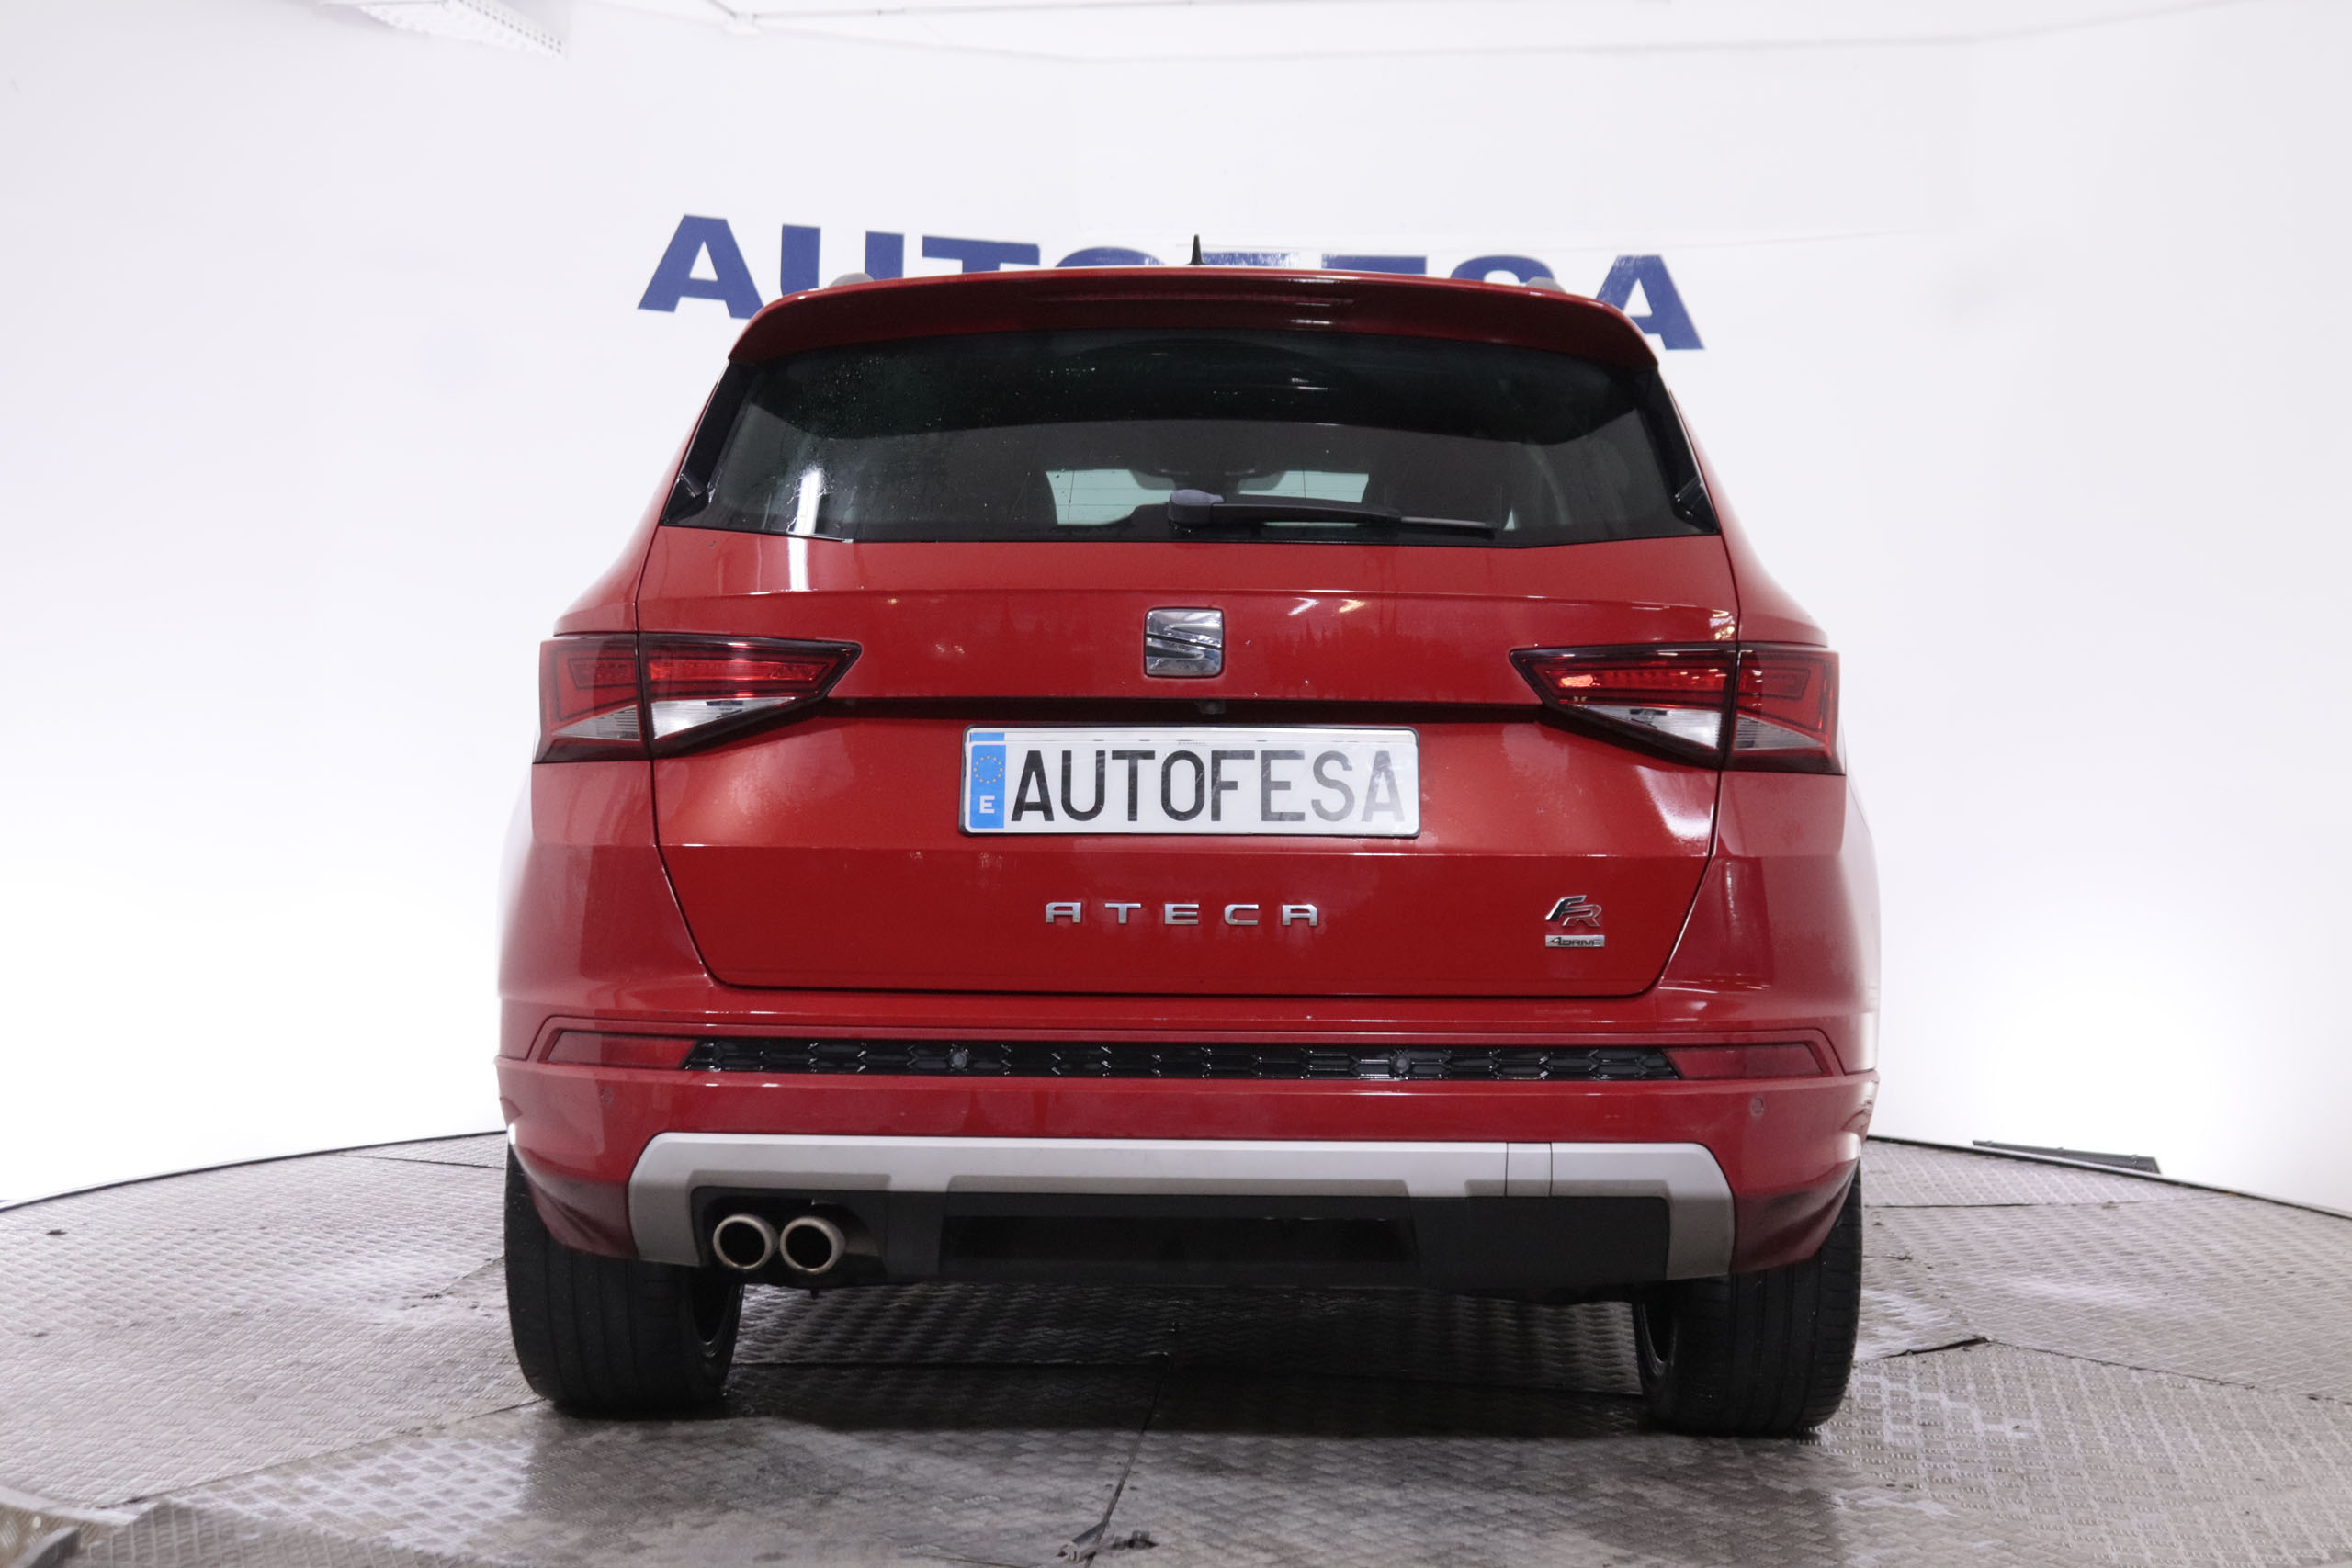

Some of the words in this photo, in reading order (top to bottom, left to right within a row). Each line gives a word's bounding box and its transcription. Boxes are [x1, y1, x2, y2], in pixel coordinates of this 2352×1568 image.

[1011, 750, 1406, 822] AUTOFESA
[979, 795, 996, 814] E
[1045, 901, 1319, 926] ATECA
[1545, 895, 1602, 927] FR
